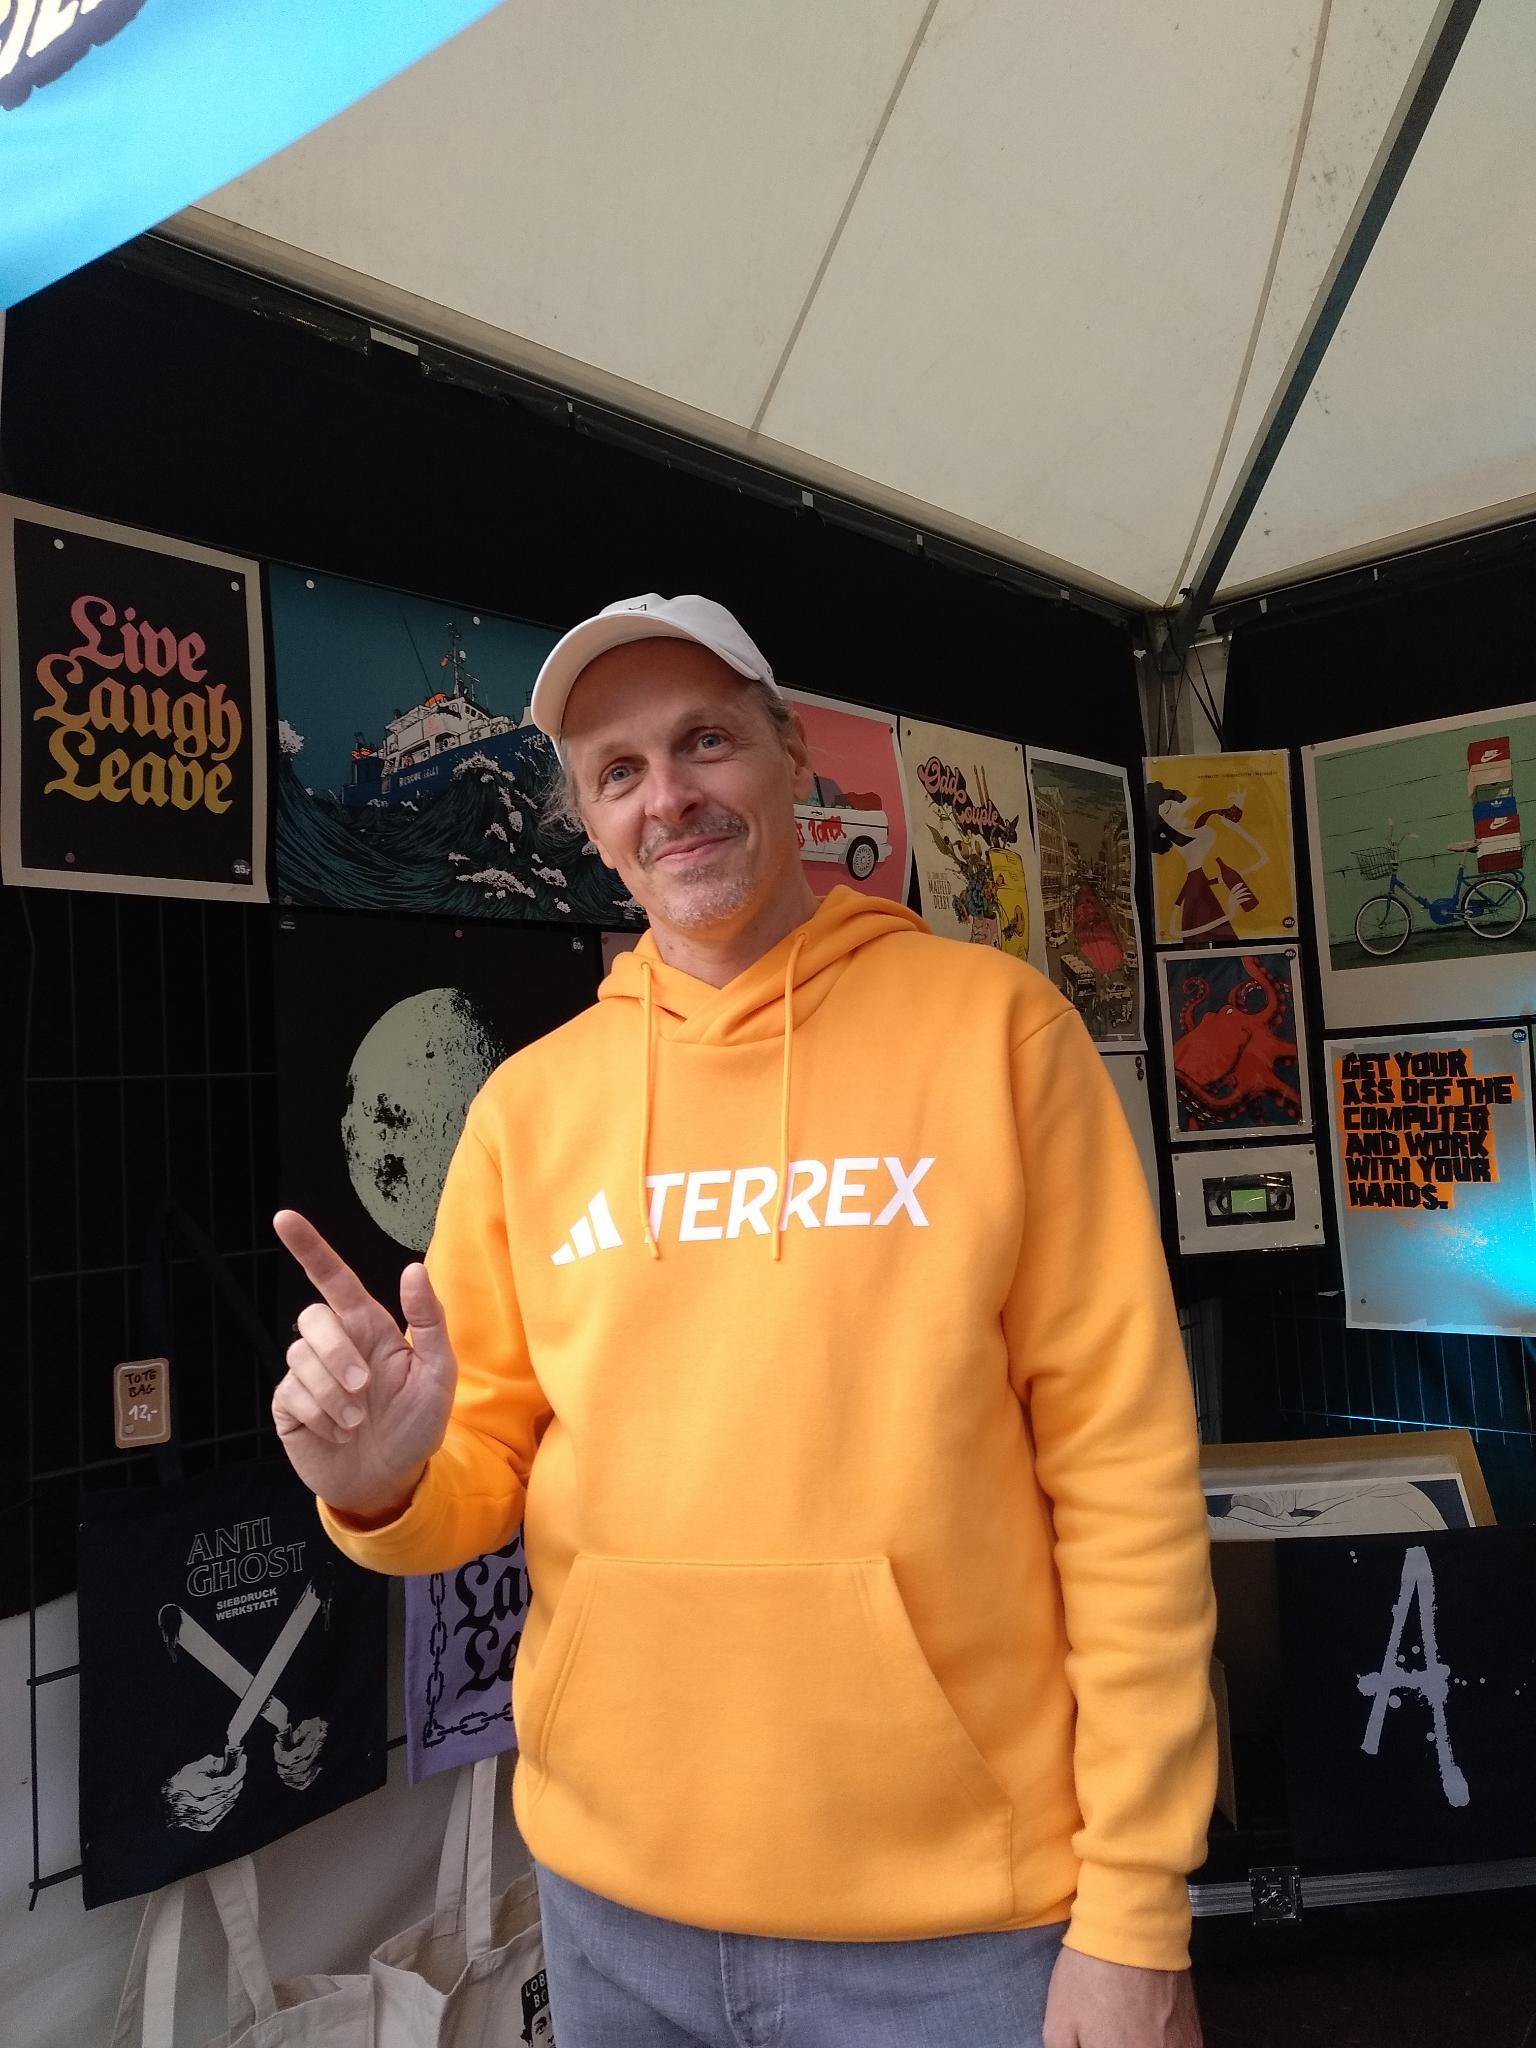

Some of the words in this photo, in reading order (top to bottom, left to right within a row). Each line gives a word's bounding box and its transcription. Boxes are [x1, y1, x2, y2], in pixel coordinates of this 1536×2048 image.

[68, 595, 208, 683] Live
[33, 653, 242, 761] Laugh
[43, 726, 233, 814] Leave
[1342, 1052, 1390, 1080] GET
[1393, 1048, 1468, 1077] YOUR
[1342, 1079, 1395, 1104] ASS
[1400, 1078, 1453, 1104] OFF
[1456, 1076, 1514, 1104] THE
[1343, 1104, 1490, 1132] COMPUTER
[1345, 1131, 1400, 1156] AND
[1404, 1130, 1489, 1157] WORK
[1345, 1157, 1410, 1181] WITH
[1417, 1157, 1491, 1182] YOUR
[643, 1157, 936, 1244] TERREX
[1348, 1182, 1448, 1210] HANDS.
[125, 1368, 157, 1384] TOTE
[128, 1384, 155, 1398] BAG
[186, 1516, 272, 1566] ANTI
[186, 1541, 306, 1597] GHOST
[215, 1597, 279, 1621] WERKSTATT
[216, 1587, 278, 1610] SIEBDRUCK
[454, 1560, 533, 1636] La
[456, 1626, 521, 1700] Le
[525, 1973, 545, 1997] LOB
